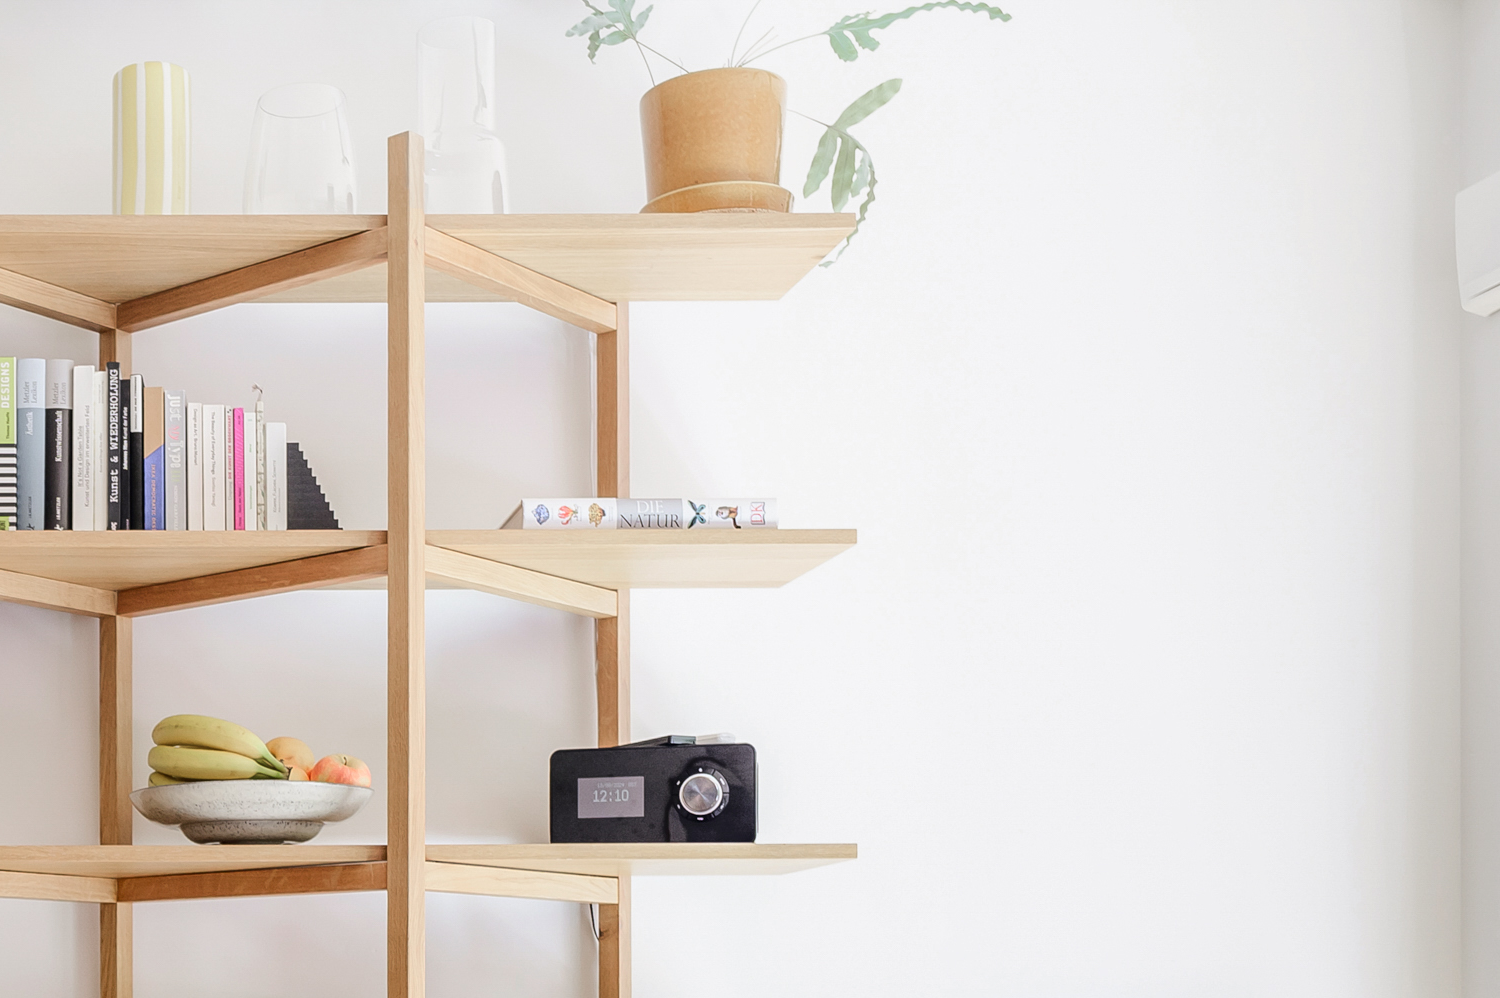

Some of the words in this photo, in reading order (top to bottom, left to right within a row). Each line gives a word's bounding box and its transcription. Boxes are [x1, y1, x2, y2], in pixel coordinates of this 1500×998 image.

[0, 361, 10, 408] DESIGNS
[109, 369, 118, 450] WIEDERHOLUNG
[25, 411, 33, 436] Ästhetik
[84, 450, 90, 458] im
[110, 455, 118, 463] &
[168, 440, 184, 468] Type
[109, 469, 118, 503] Kunst
[636, 500, 664, 513] DIE
[751, 504, 763, 523] DK
[620, 514, 680, 528] NATUR
[593, 789, 629, 803] 12:10
